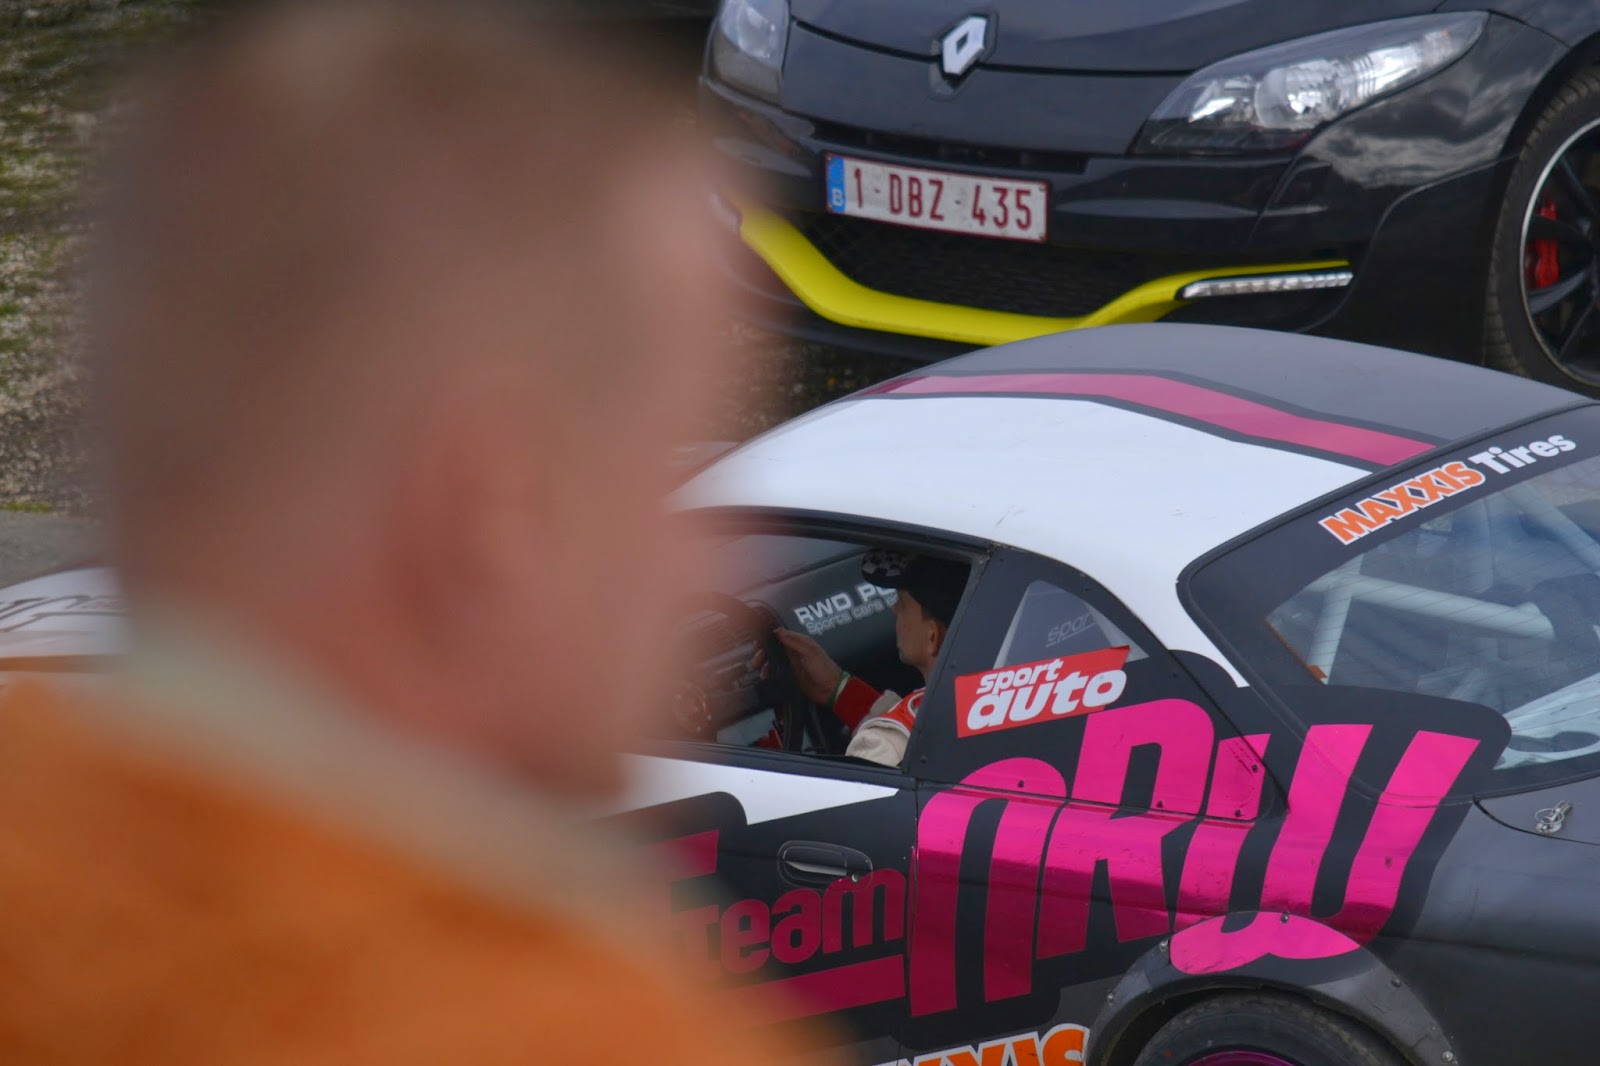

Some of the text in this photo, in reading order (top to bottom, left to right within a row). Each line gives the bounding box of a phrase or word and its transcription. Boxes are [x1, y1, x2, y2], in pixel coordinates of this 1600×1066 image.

[831, 187, 844, 207] B
[1318, 434, 1577, 545] MAXXIS Tires
[793, 592, 852, 625] RWD
[806, 611, 851, 633] Sports
[853, 600, 883, 618] cars
[976, 658, 1064, 695] sport
[966, 669, 1127, 731] auto
